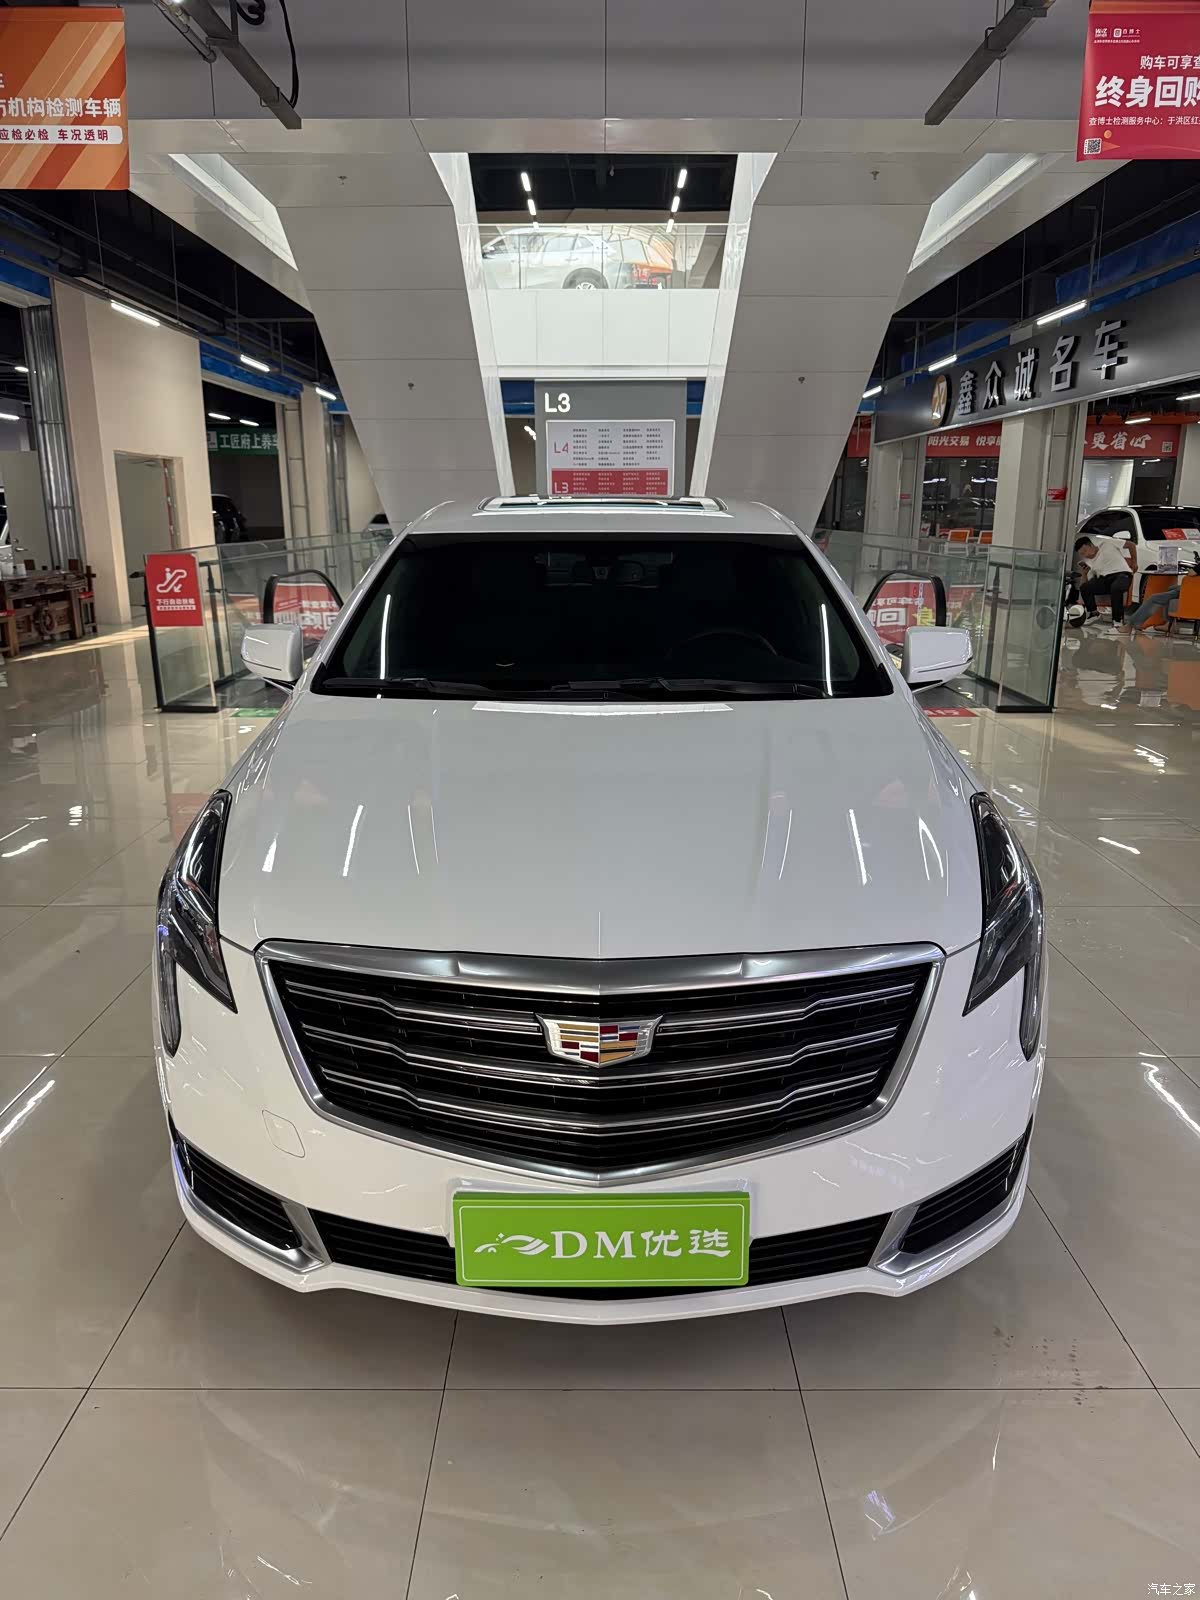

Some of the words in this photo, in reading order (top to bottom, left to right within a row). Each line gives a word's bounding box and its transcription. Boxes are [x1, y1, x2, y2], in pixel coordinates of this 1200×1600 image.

[1088, 116, 1200, 126] 查博士检测服务中心：于洪区红
[57, 128, 109, 141] 车况透明
[956, 319, 1126, 416] 鑫众诚名车
[544, 392, 571, 413] L3
[927, 435, 970, 447] 阳光交易
[1083, 431, 1152, 450] 更省心
[554, 442, 569, 454] L4
[554, 482, 569, 494] L3
[550, 1227, 732, 1258] DM优选
